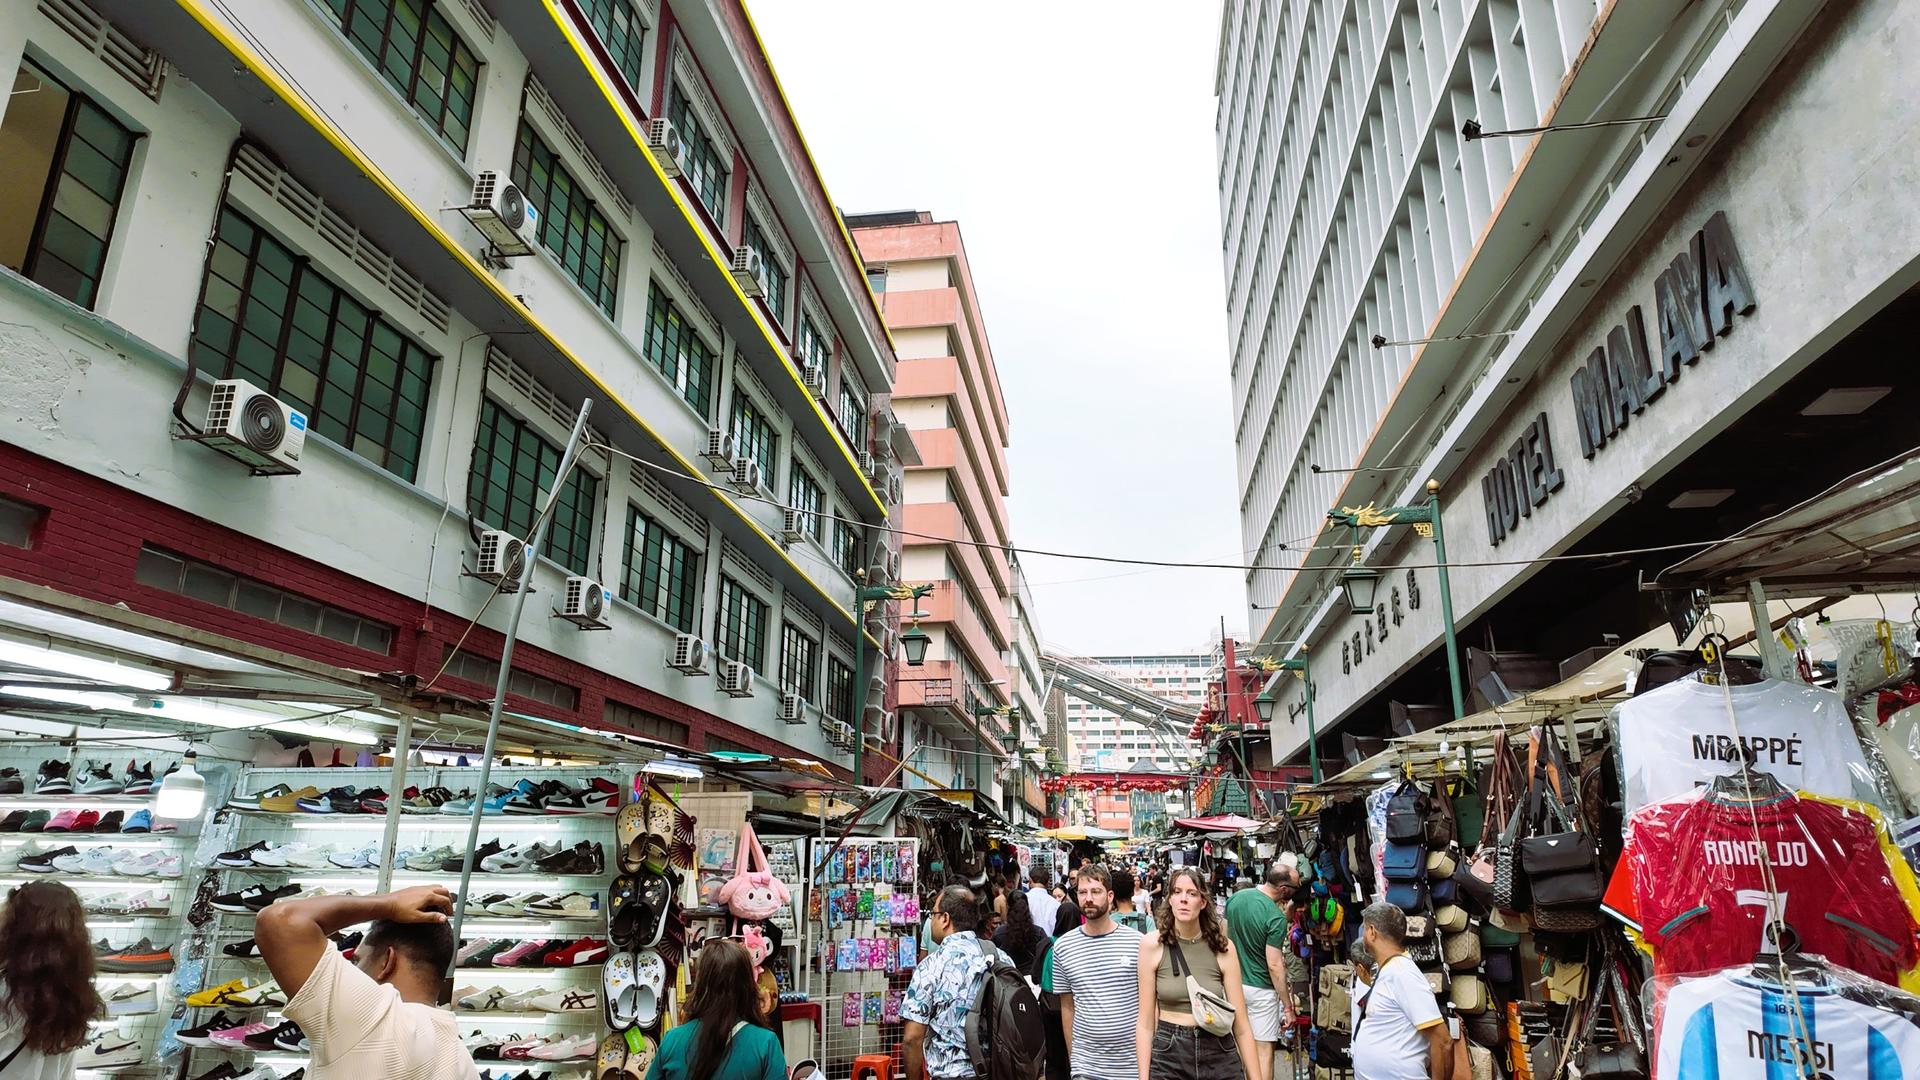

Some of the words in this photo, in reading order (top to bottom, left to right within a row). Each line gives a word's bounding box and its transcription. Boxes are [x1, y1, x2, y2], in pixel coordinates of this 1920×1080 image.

[1481, 411, 1564, 547] HOTEL
[1570, 210, 1757, 460] MALAYA
[1692, 732, 1802, 766] MBAPPÉ
[1703, 840, 1808, 867] RONALDO
[1735, 889, 1788, 954] 7
[1774, 1003, 1801, 1015] 189
[1747, 1029, 1835, 1071] MESSI
